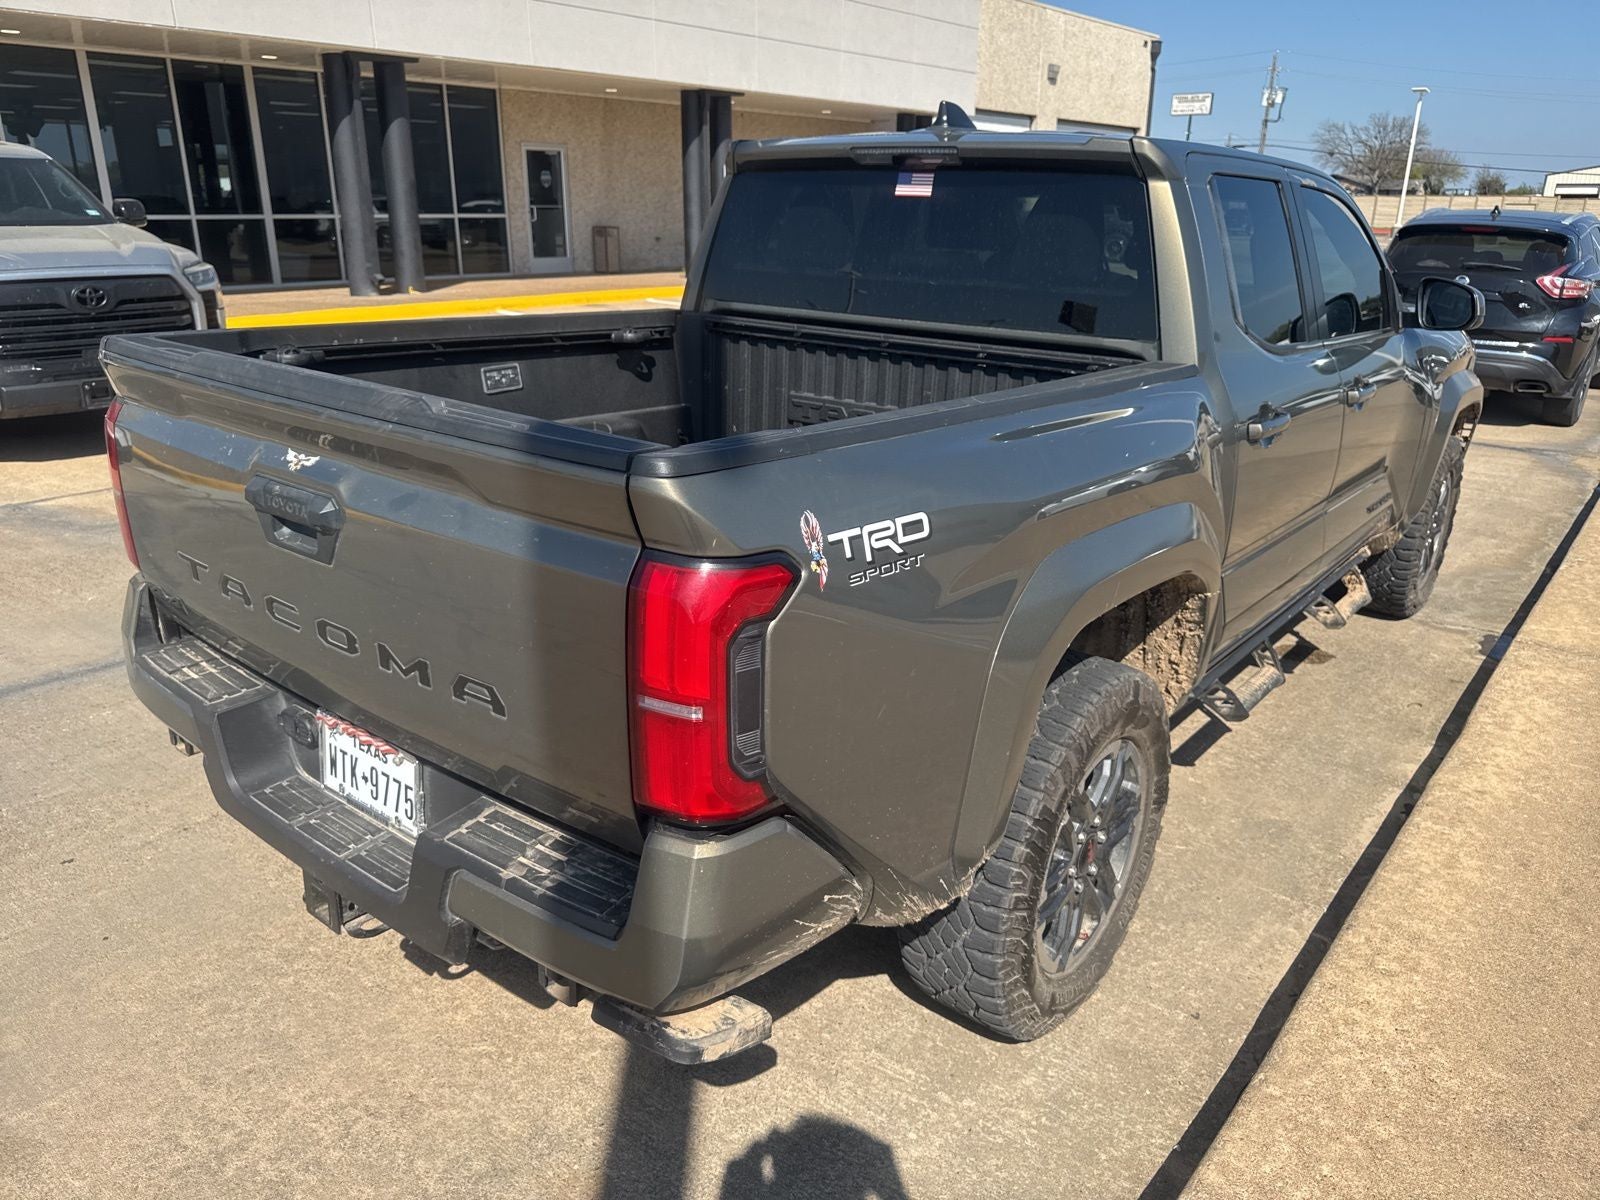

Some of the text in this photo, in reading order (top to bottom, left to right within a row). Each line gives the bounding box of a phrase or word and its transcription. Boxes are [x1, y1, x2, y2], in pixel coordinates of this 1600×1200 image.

[265, 493, 309, 519] TOYOTA
[826, 511, 931, 563] TRD
[849, 553, 925, 587] SPORT
[177, 550, 508, 720] TACOMA
